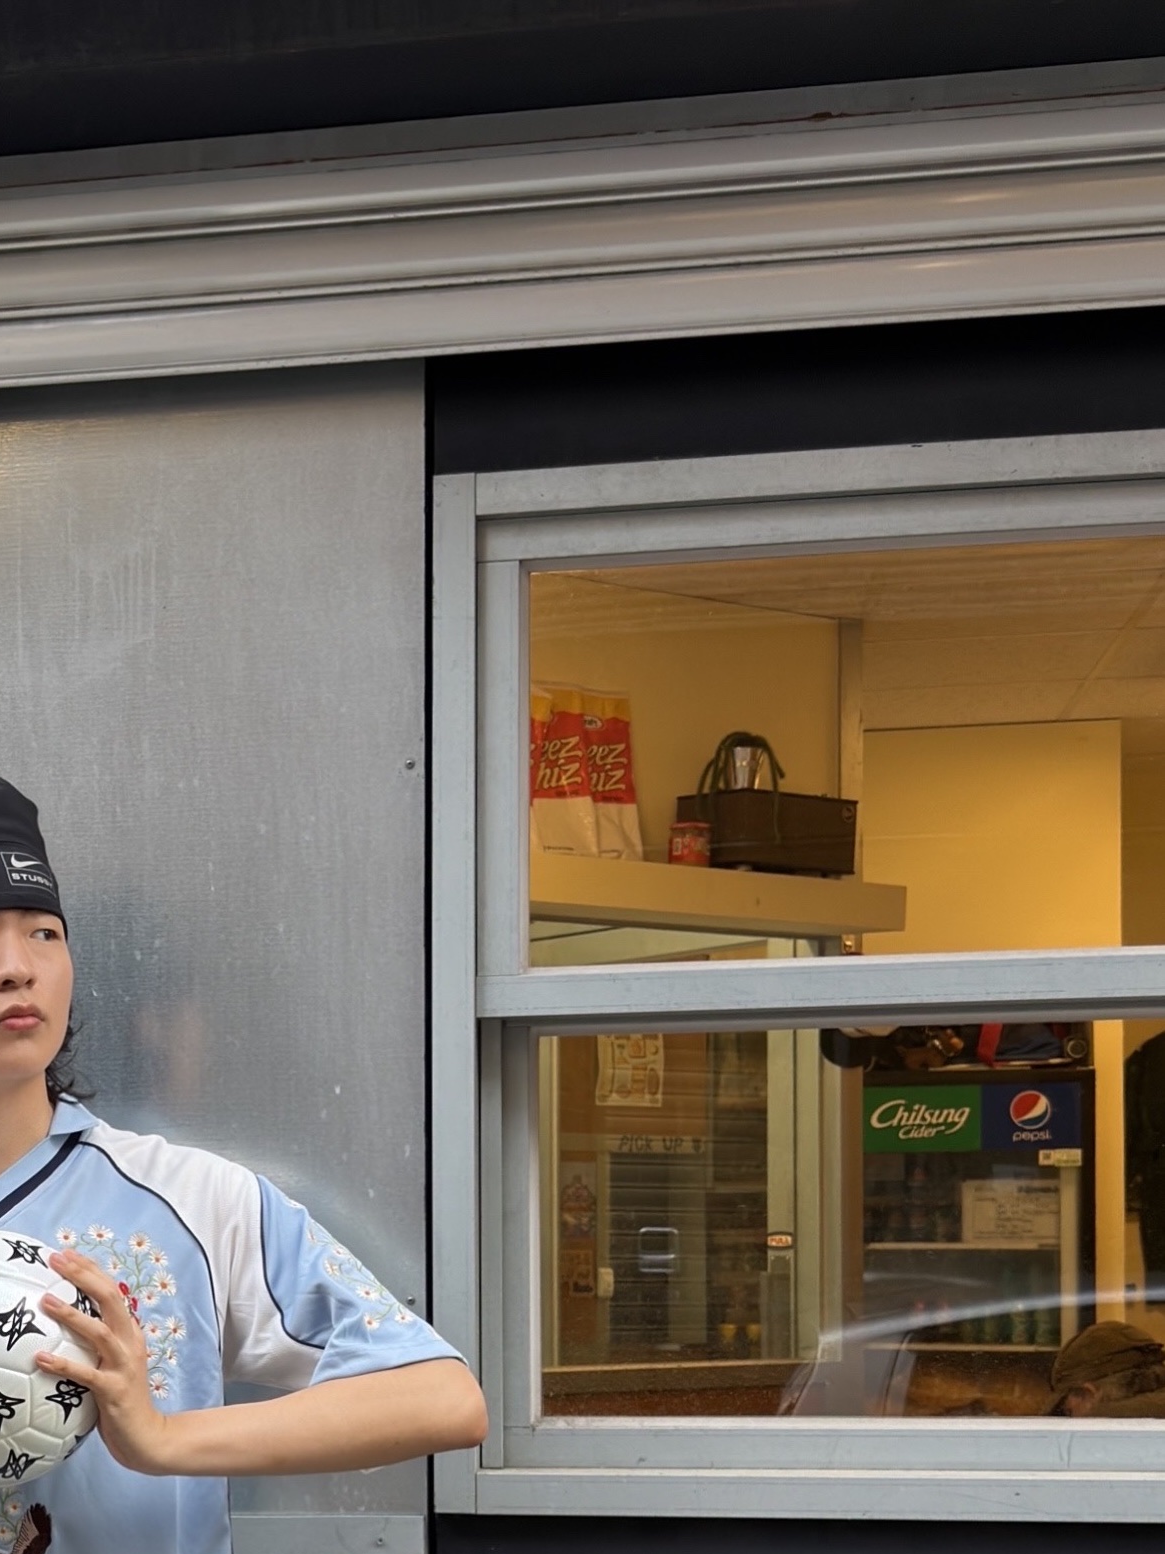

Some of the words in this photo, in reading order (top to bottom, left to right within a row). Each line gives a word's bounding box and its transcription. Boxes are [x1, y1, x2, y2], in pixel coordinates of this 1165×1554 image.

[870, 1099, 970, 1134] Chilsung
[898, 1126, 946, 1139] Cider
[1012, 1130, 1050, 1142] pepsi
[662, 1136, 684, 1152] UP
